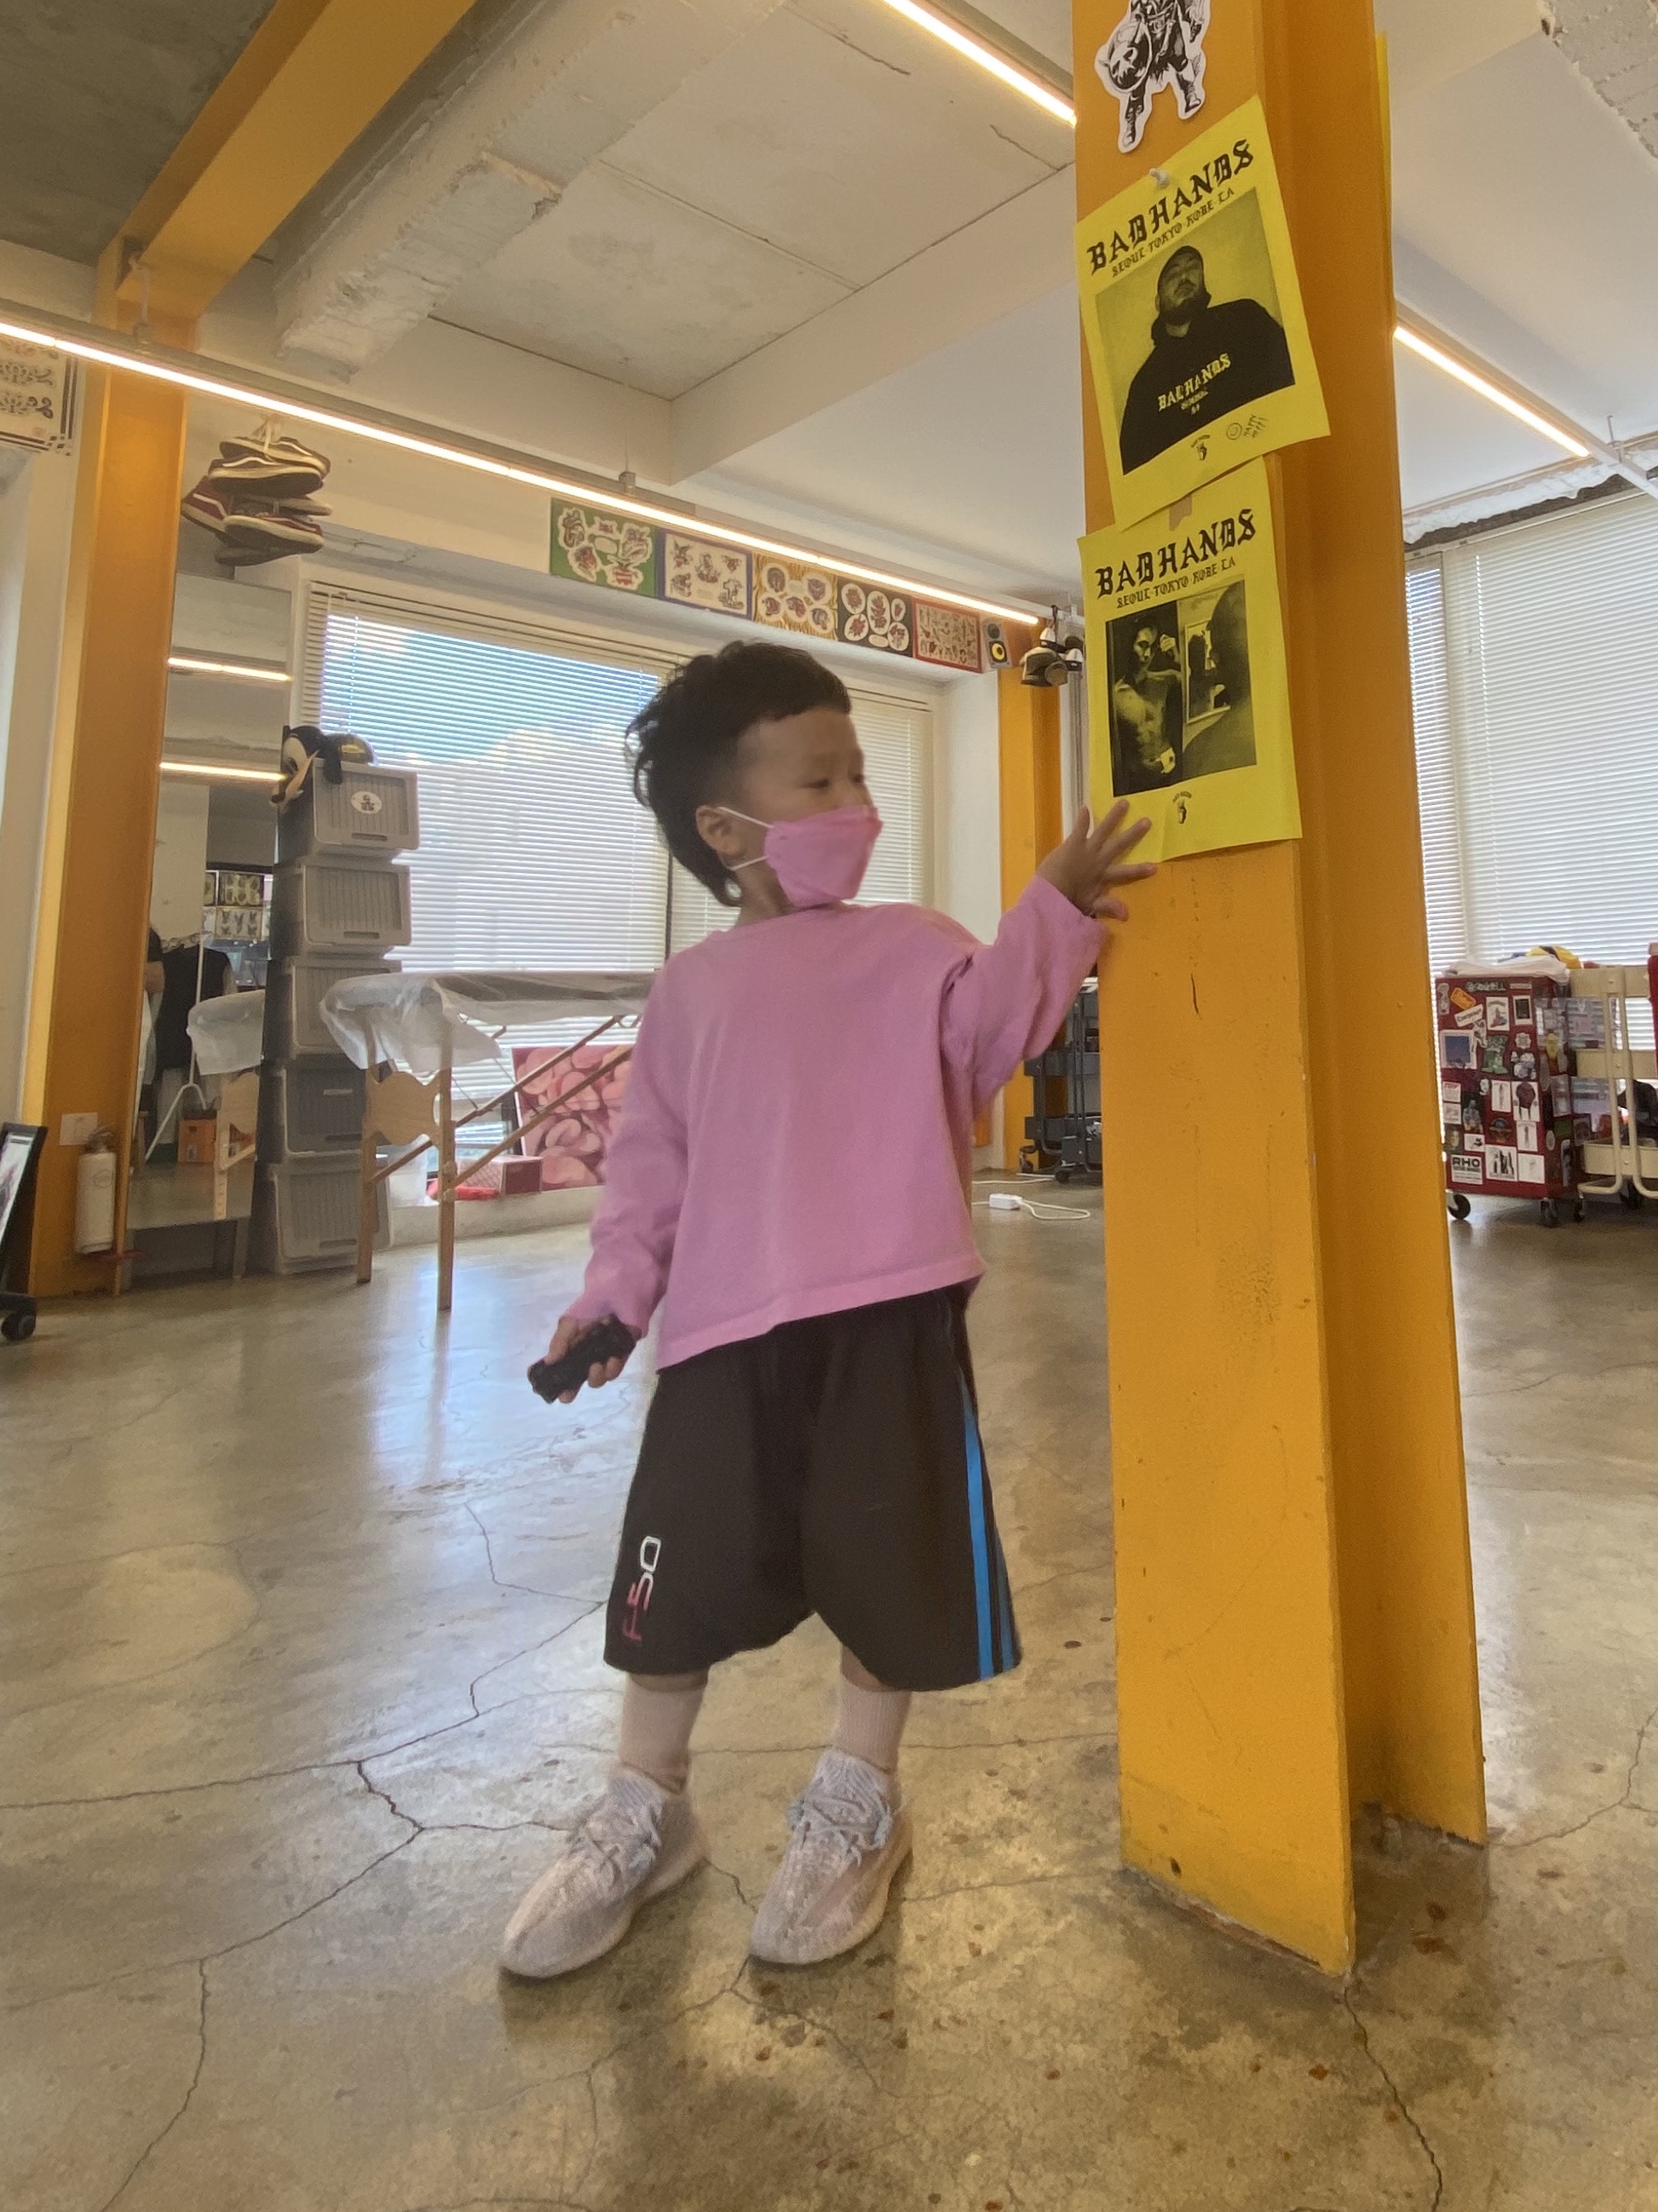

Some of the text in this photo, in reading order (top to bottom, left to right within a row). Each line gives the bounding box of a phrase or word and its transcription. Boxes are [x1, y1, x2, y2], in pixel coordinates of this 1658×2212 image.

[1112, 187, 1235, 278] SEOUL TOKYO KOBE LA
[1117, 556, 1235, 608] SEOUL TOKYO KOBE LA
